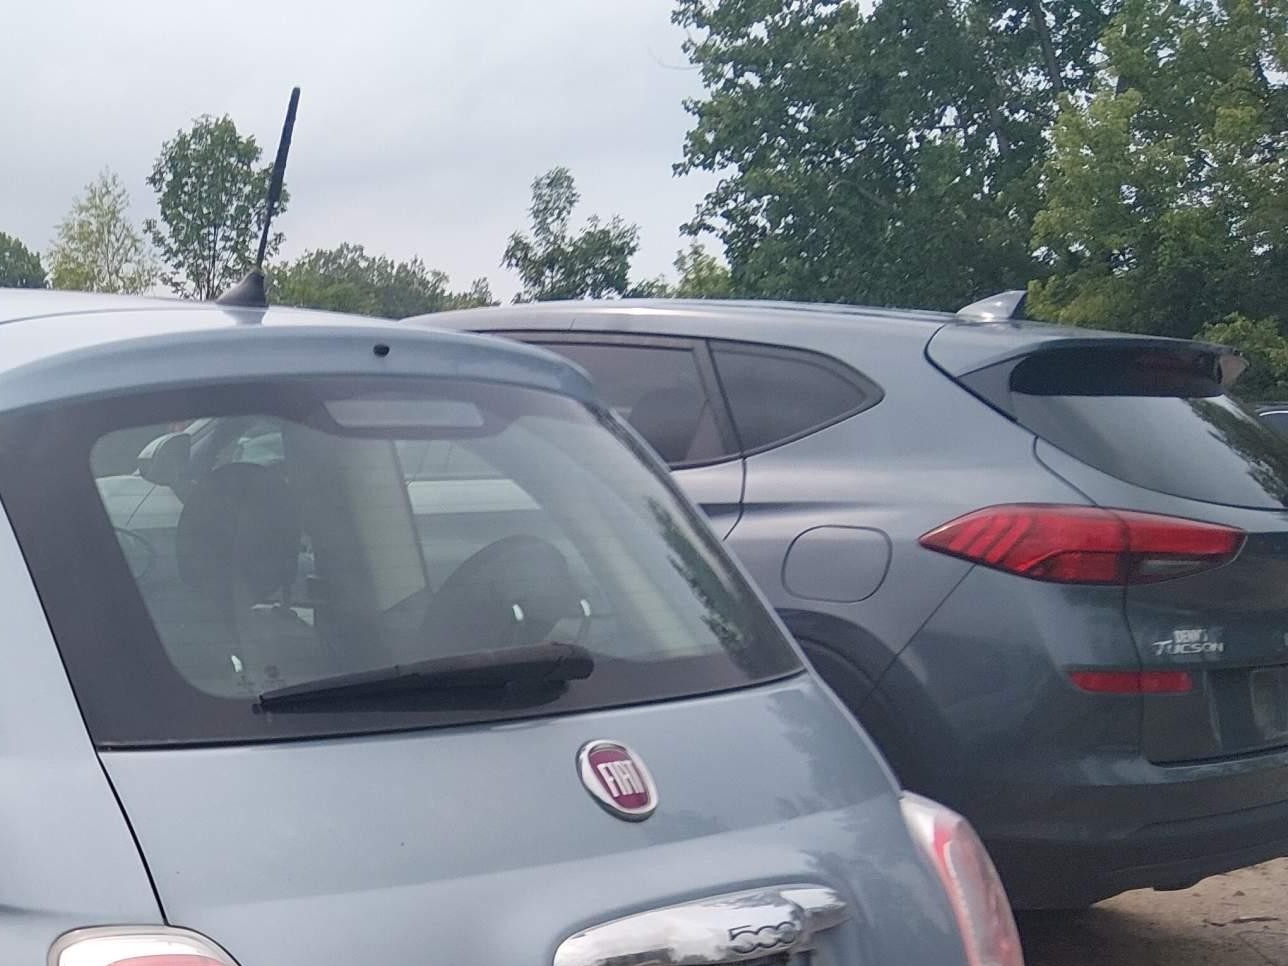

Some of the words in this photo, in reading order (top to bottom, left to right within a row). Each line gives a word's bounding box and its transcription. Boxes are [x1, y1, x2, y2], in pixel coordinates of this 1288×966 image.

[1152, 640, 1224, 656] TUCSON
[597, 760, 646, 798] FIAT
[728, 921, 796, 954] 500
